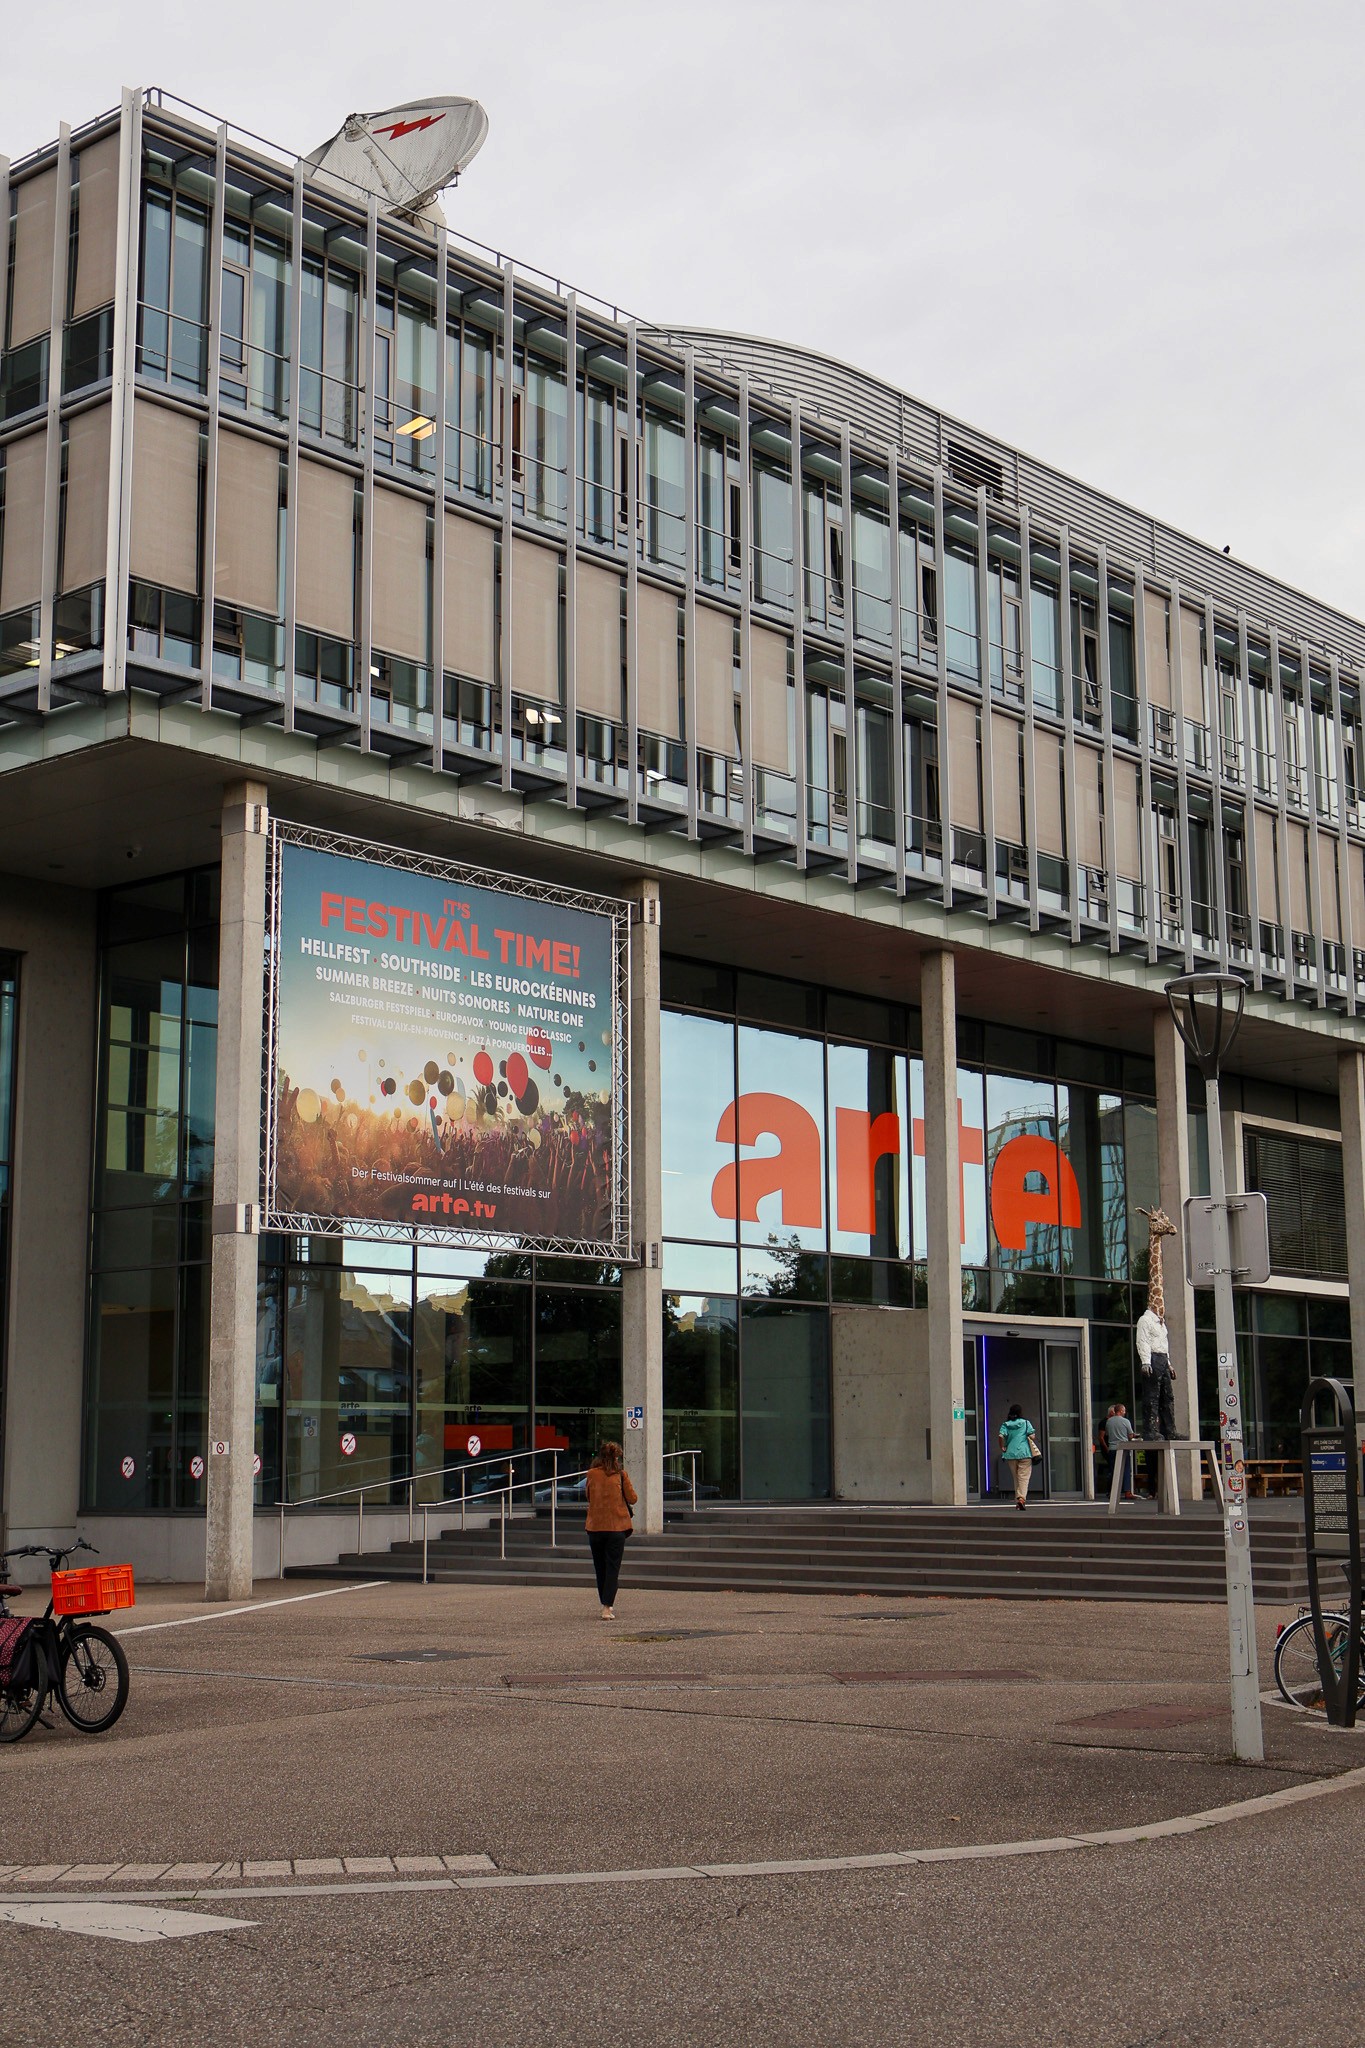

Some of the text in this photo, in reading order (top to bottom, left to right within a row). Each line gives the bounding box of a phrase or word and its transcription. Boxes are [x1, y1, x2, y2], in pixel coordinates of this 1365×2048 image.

[443, 898, 471, 919] IT'S
[320, 891, 581, 979] FESTIVAL TIME!
[301, 937, 597, 1009] HELLFEST SOUTHSIDE LES EUROCKÉENNES
[315, 966, 584, 1028] SUMMER BREEZE NUITS SONORES NATURE ONE
[329, 991, 572, 1043] SALZBURGER FESTSPIELE EUROPAVOX YOUNG EURO CLASSIC
[351, 1014, 387, 1029] FESTIVAL
[468, 1035, 485, 1046] JAZZ
[485, 1035, 491, 1046] À
[492, 1039, 546, 1056] PORQUEROLLES
[351, 1167, 369, 1179] Der
[371, 1169, 442, 1187] Festivalsommer
[442, 1178, 458, 1188] auf
[464, 1180, 484, 1192] L'été
[486, 1183, 501, 1194] des
[503, 1184, 537, 1198] festivals
[538, 1190, 551, 1199] sur
[711, 1092, 1081, 1250] arte
[411, 1193, 497, 1219] arte.tv
[340, 1401, 360, 1409] arte
